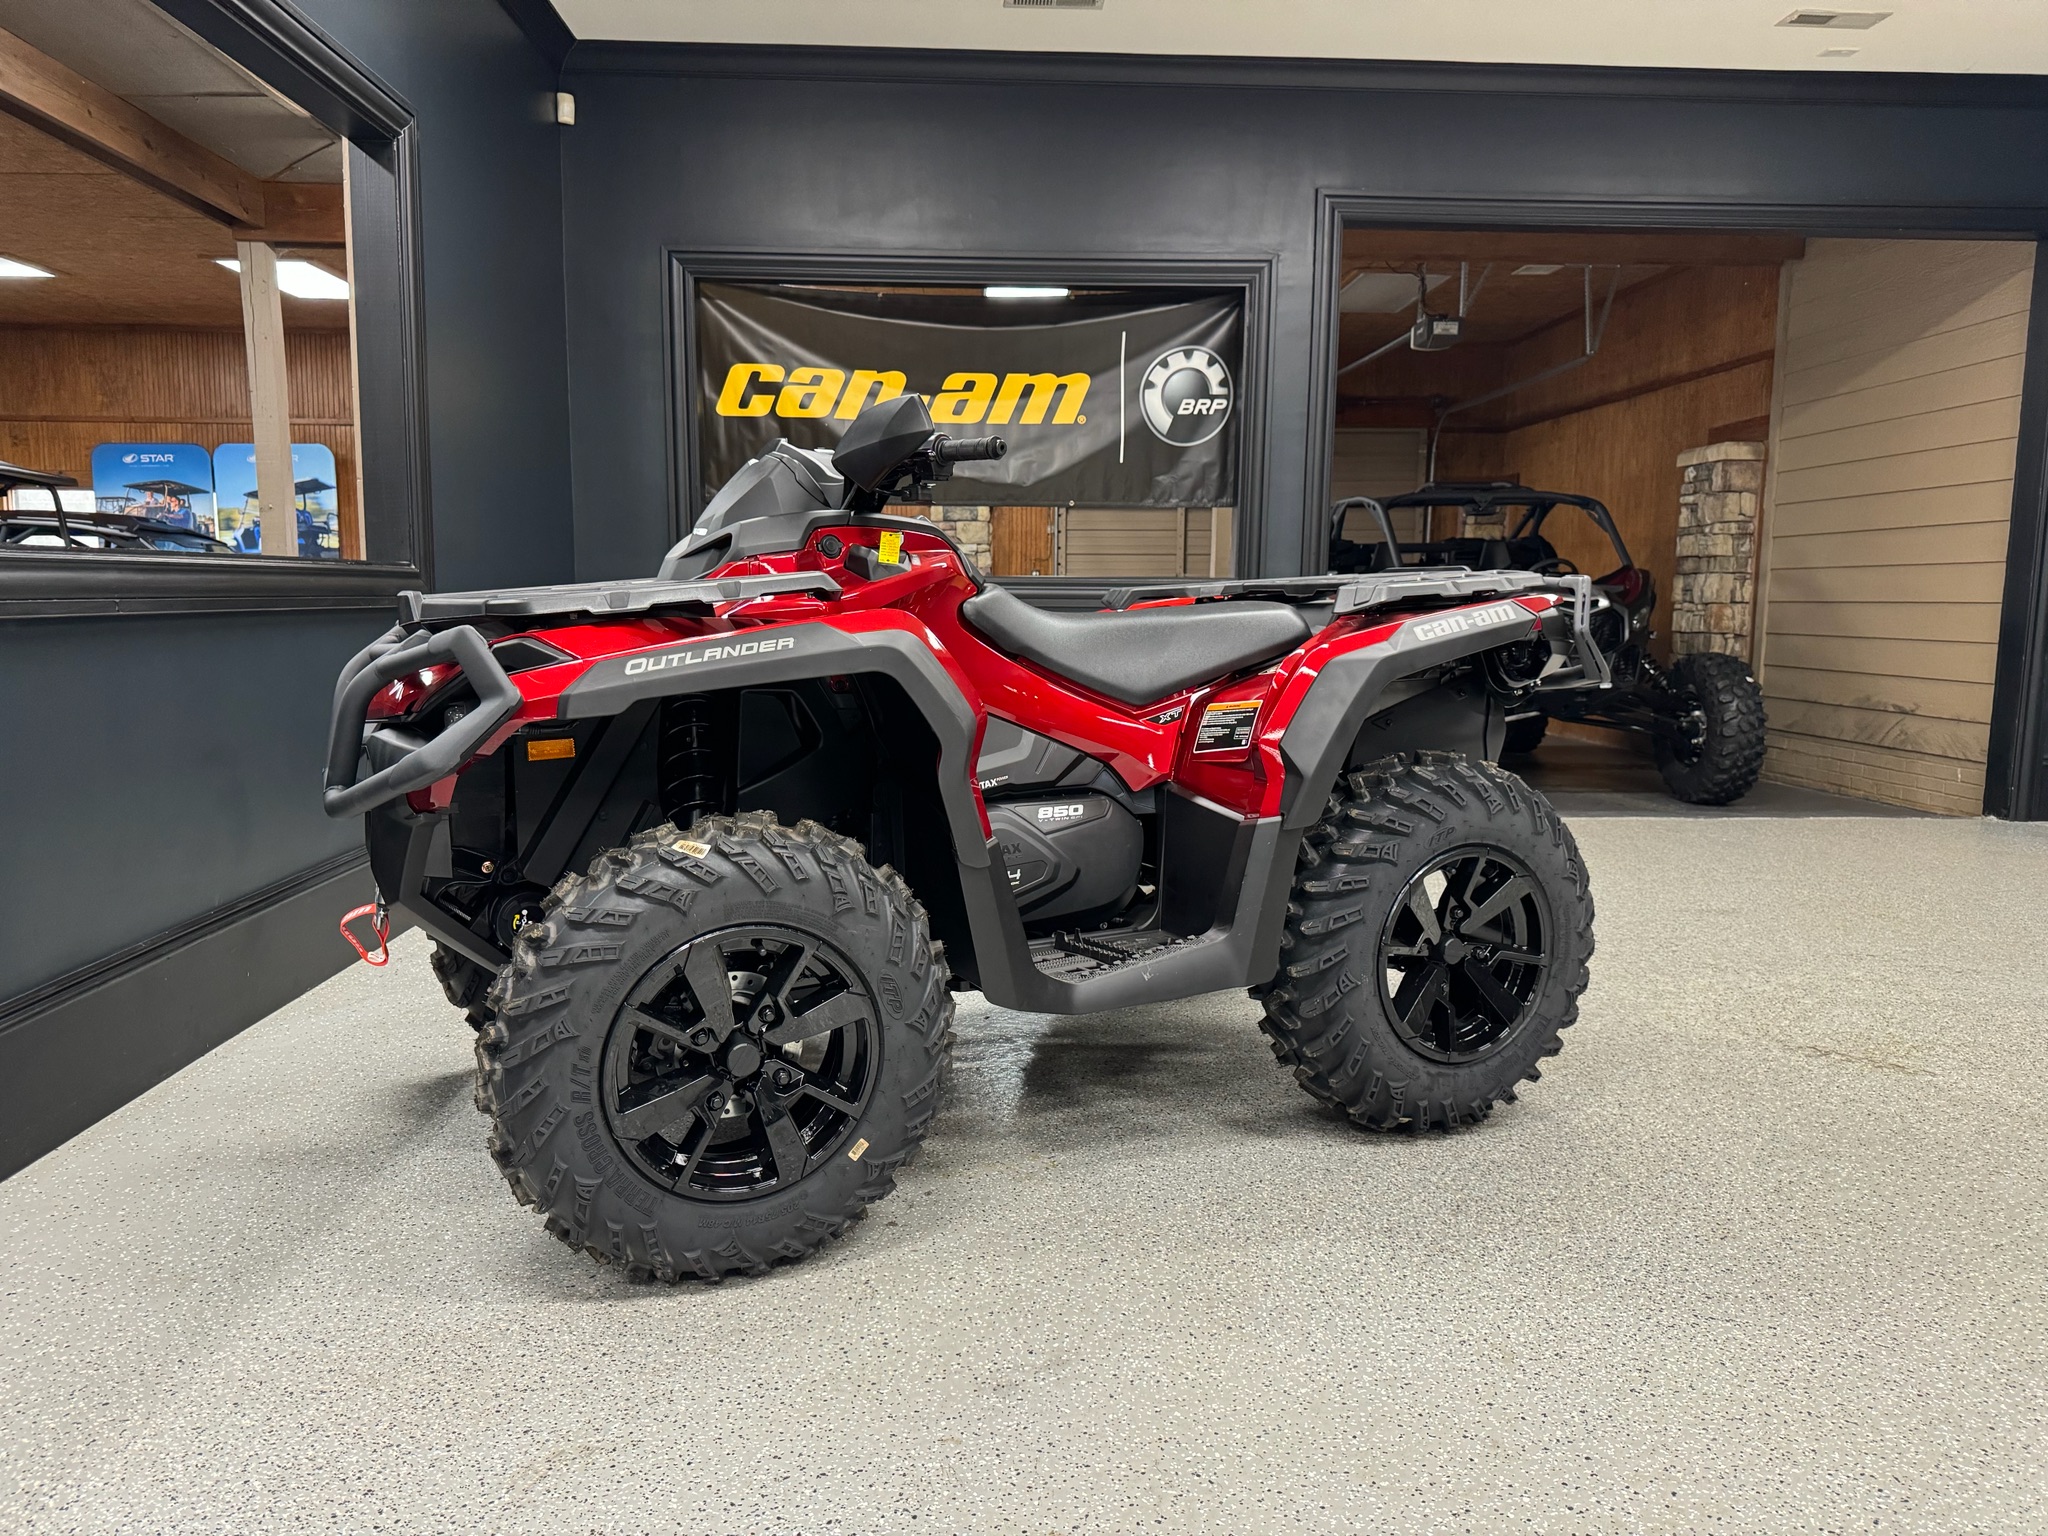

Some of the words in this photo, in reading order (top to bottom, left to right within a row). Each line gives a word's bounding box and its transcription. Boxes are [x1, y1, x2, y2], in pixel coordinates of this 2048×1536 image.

[1177, 398, 1228, 415] BRP
[140, 454, 174, 463] STAR
[1413, 604, 1517, 641] can-am
[624, 637, 795, 676] OUTLANDER
[1159, 706, 1182, 723] XT
[1038, 804, 1084, 819] 850
[880, 974, 903, 1013] ITP
[570, 1063, 592, 1104] R/T
[573, 1110, 615, 1175] CROSS
[604, 1166, 659, 1217] TERRA
